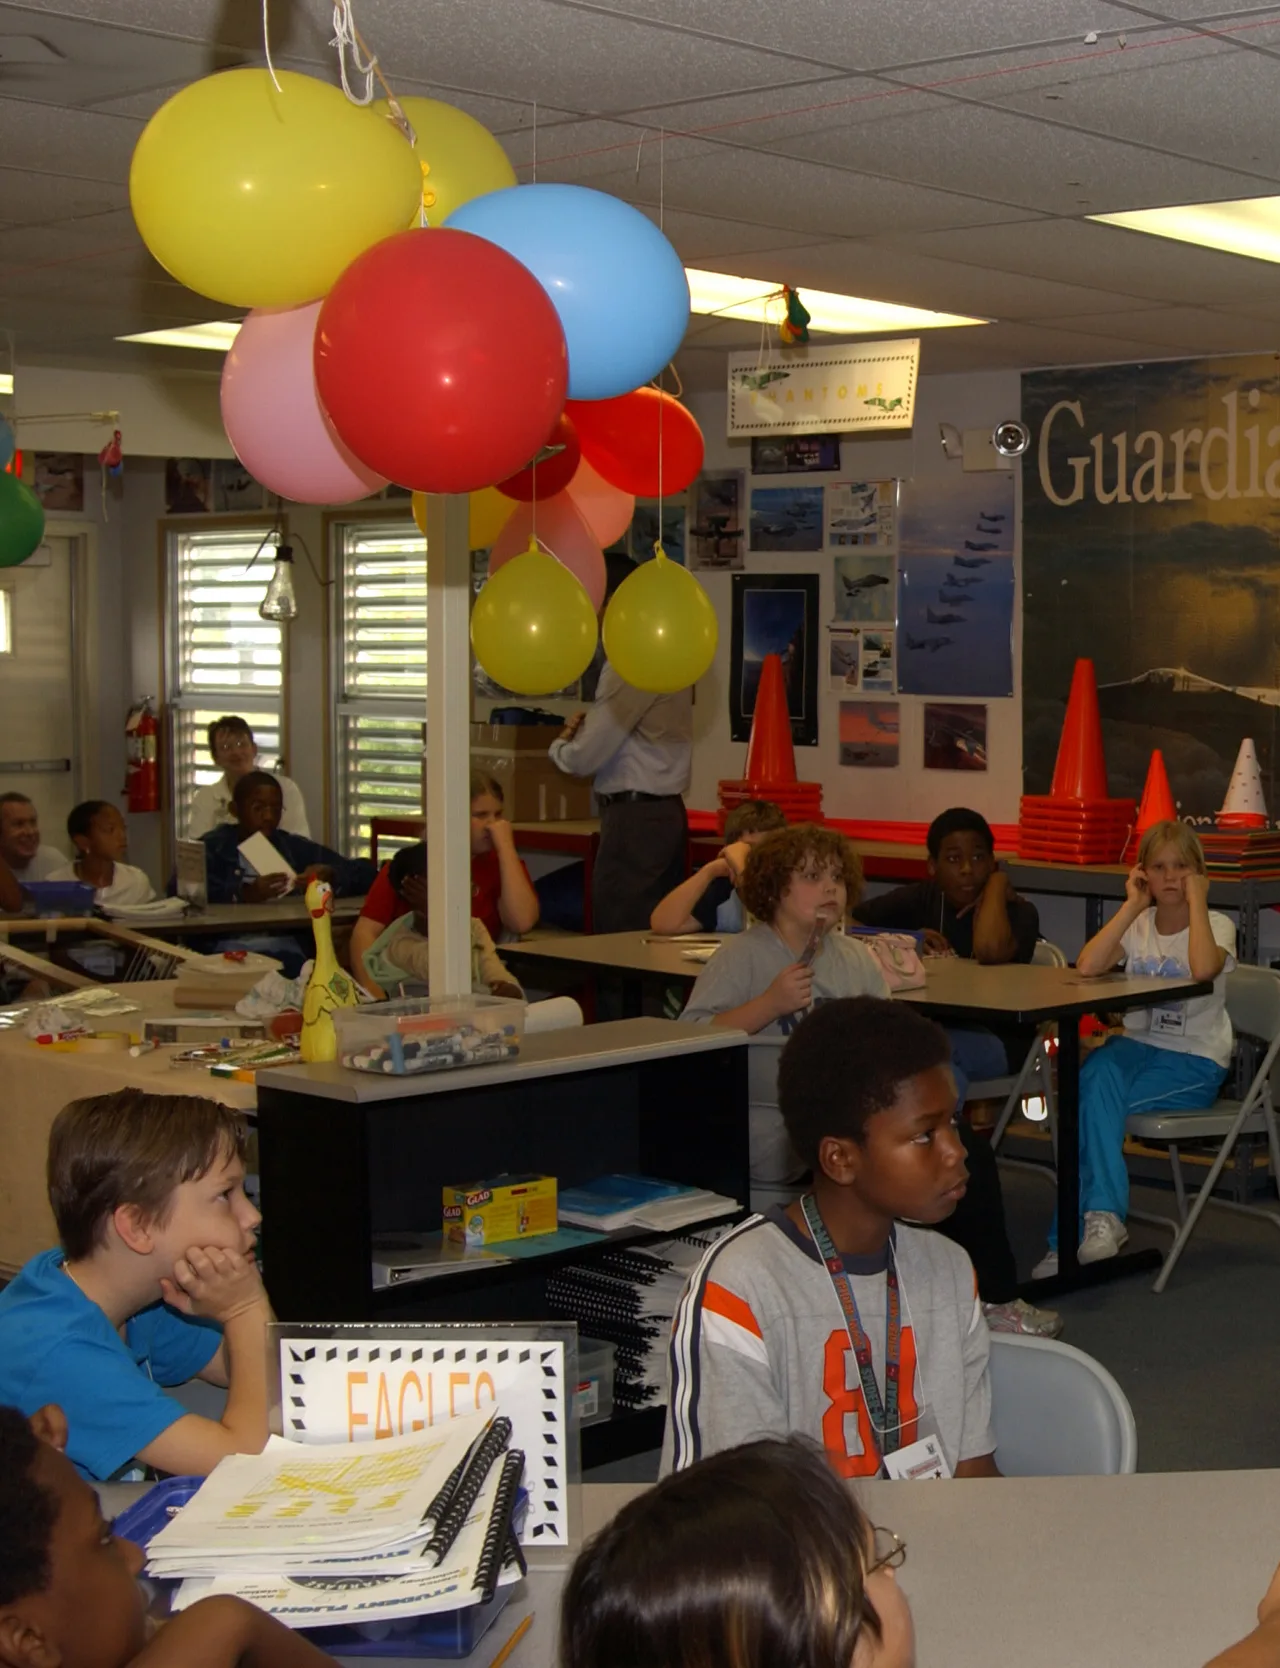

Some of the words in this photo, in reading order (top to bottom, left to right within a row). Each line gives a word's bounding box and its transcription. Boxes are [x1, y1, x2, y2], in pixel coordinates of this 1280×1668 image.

[751, 382, 883, 404] PHANTOMS
[467, 1191, 490, 1206] GLAD
[443, 1206, 461, 1217] GLAD
[353, 1584, 459, 1611] STUDENT
